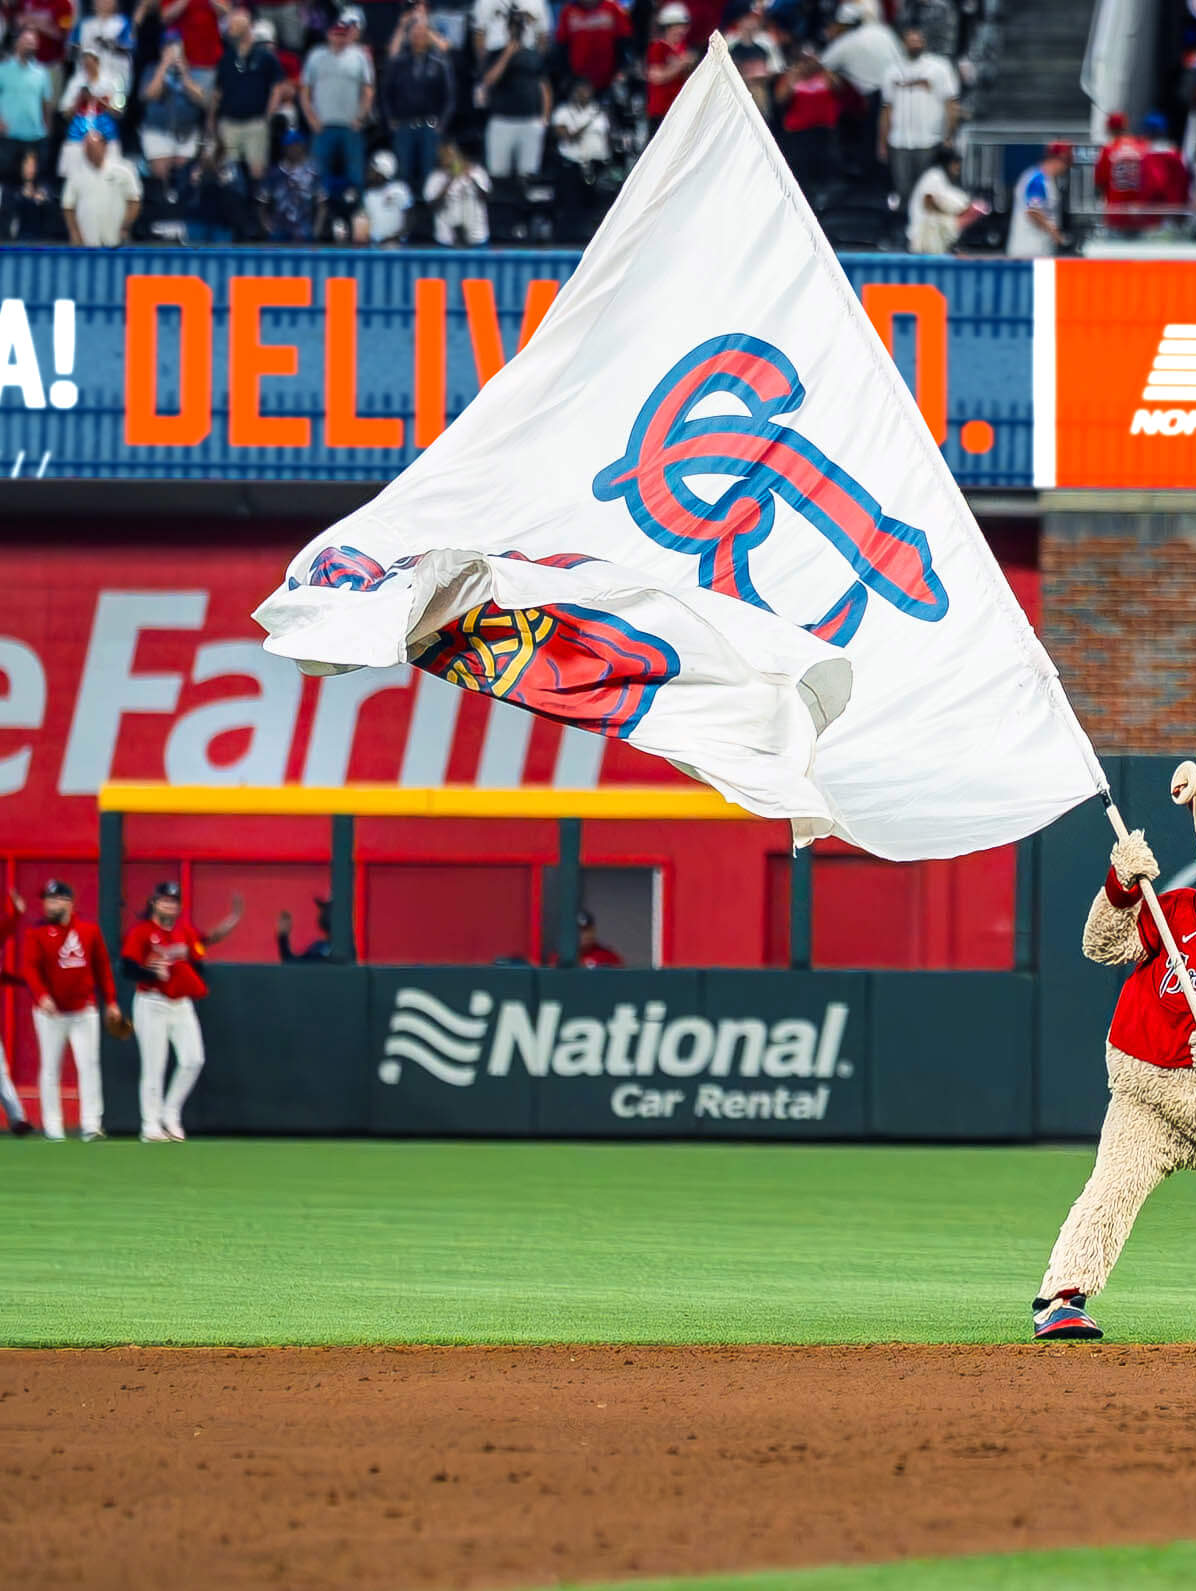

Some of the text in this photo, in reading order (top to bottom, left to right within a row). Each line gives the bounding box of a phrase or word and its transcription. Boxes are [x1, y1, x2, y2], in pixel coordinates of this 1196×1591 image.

[487, 1000, 848, 1078] National
[611, 1084, 830, 1121] Car Rental
